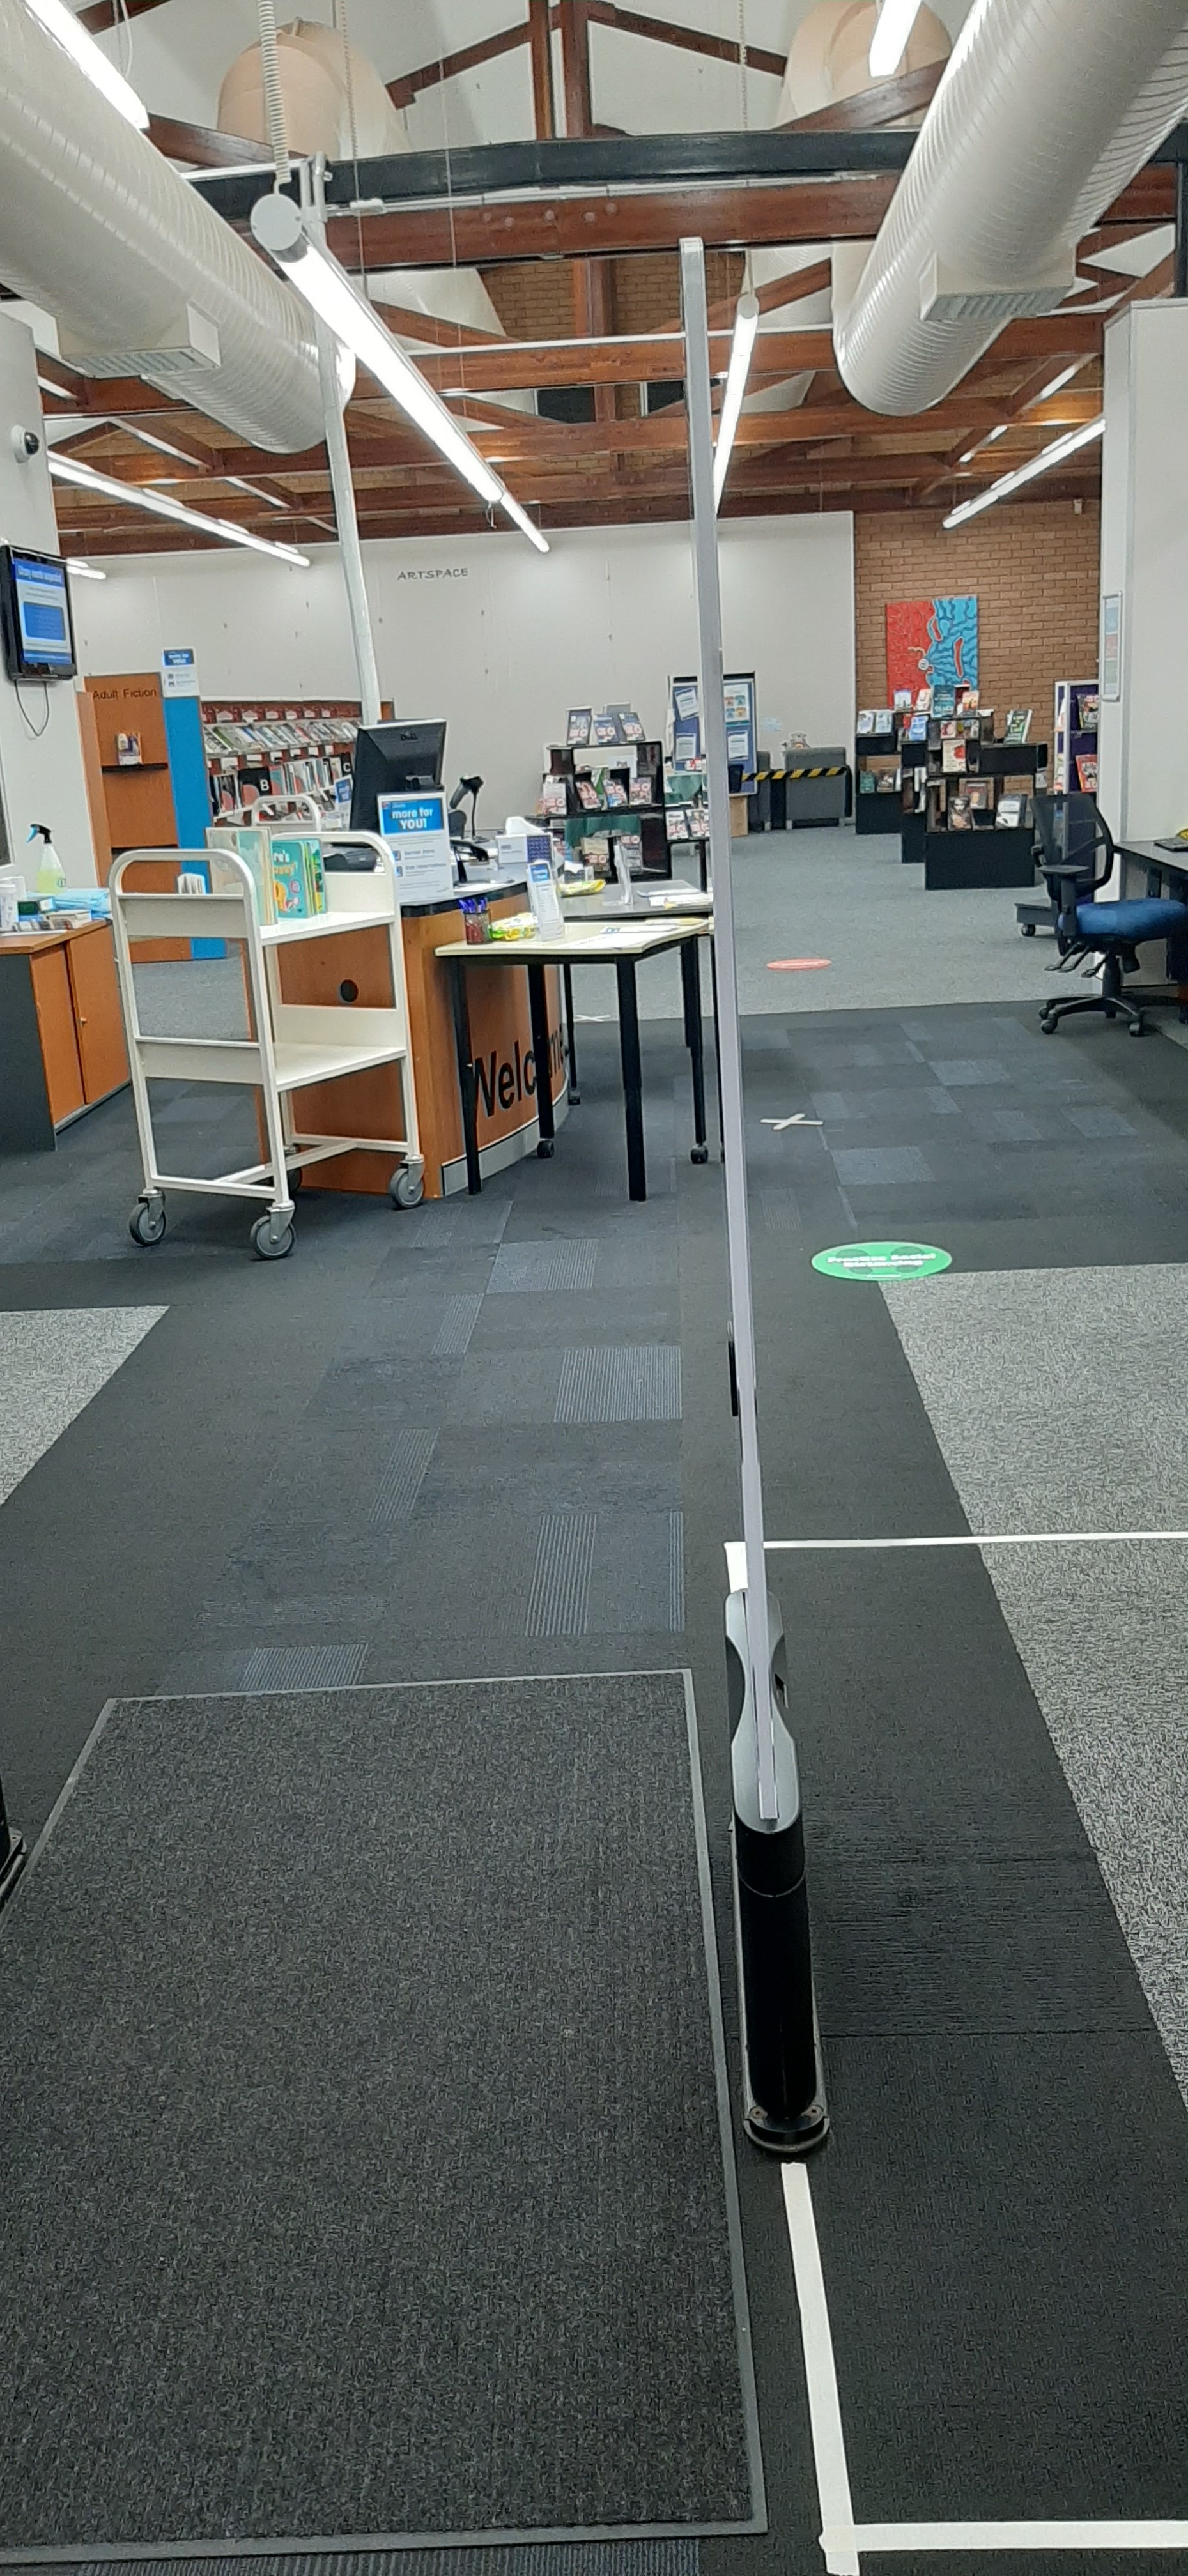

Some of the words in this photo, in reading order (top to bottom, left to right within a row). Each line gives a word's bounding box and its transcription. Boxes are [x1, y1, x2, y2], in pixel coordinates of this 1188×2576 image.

[397, 568, 468, 581] ARTSPACE
[93, 690, 118, 700] Adult
[123, 688, 157, 700] Fiction
[343, 762, 351, 772] C
[259, 779, 270, 792] B
[392, 809, 417, 819] more
[419, 806, 433, 816] for
[399, 818, 427, 830] YOU!
[472, 1023, 564, 1118] Welcme
